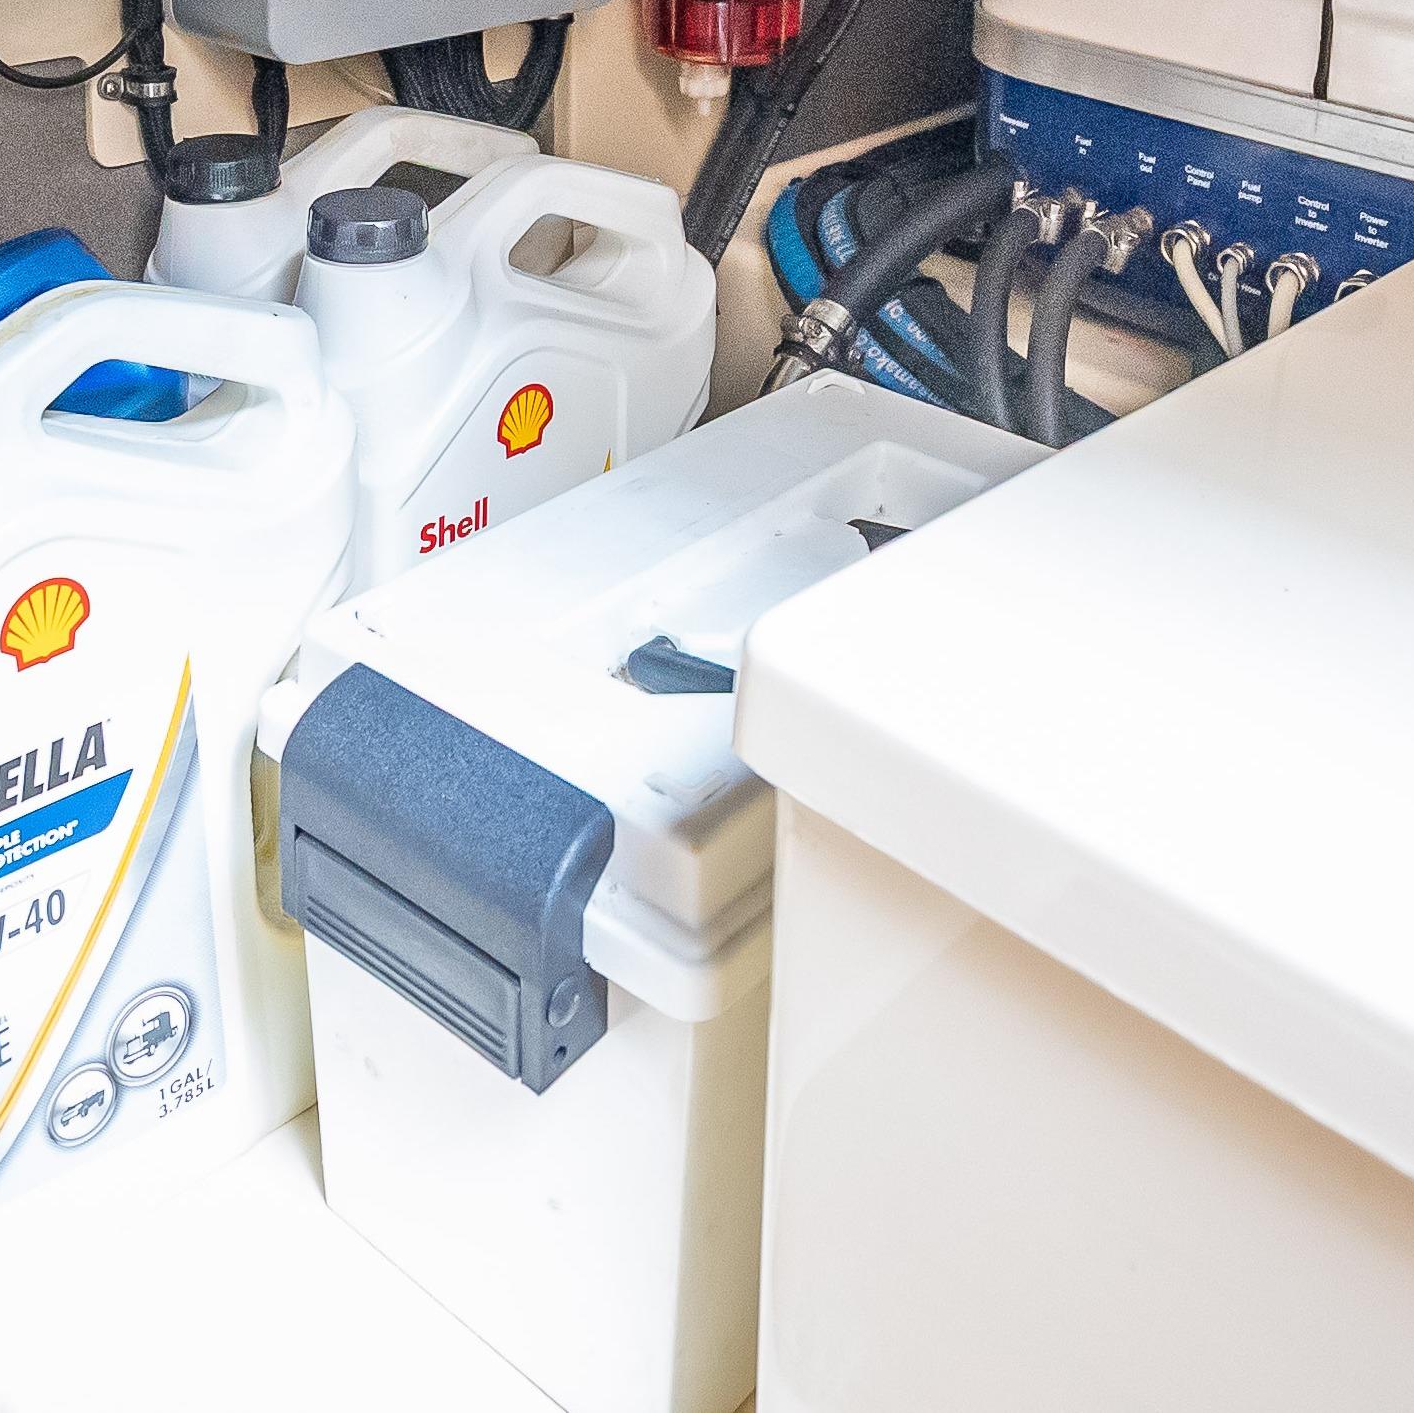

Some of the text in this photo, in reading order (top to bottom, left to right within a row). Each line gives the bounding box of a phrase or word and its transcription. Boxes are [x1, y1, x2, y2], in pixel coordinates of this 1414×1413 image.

[1184, 164, 1214, 179] Control
[1187, 175, 1211, 189] Panel
[1242, 180, 1261, 193] Fuel
[1298, 195, 1330, 211] Control
[1308, 209, 1317, 219] to
[1359, 211, 1389, 227] Power
[1368, 225, 1377, 235] to
[420, 496, 488, 554] Shell
